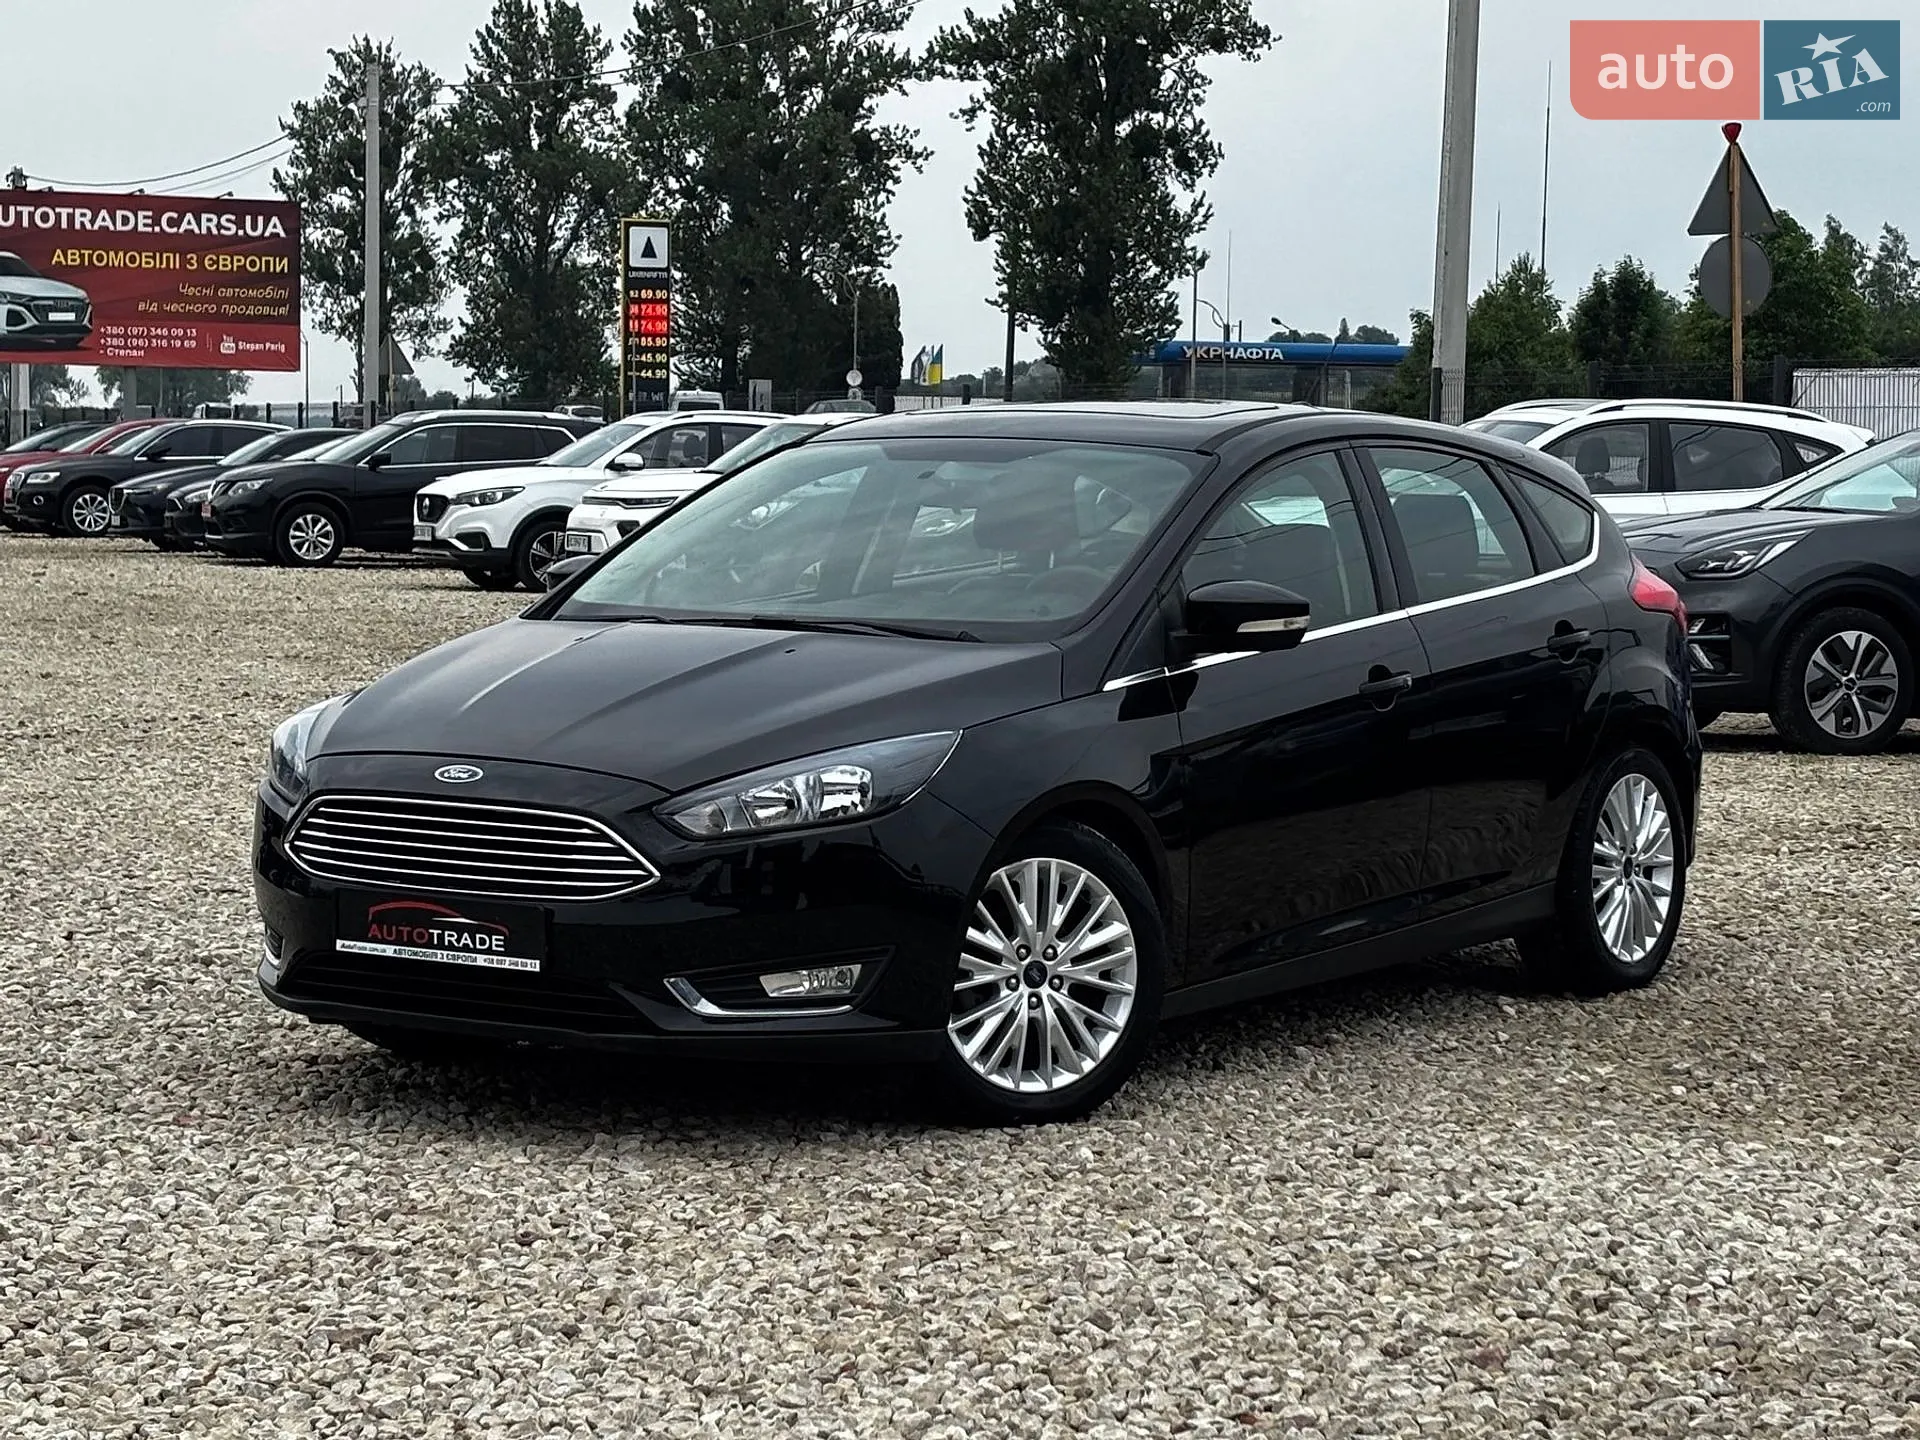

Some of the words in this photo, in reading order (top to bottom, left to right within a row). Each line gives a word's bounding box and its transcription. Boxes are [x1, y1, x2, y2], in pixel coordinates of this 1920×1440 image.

[51, 249, 180, 270] АВТОМОБІЛІ
[204, 254, 289, 274] ЄВРОПИ
[179, 283, 215, 296] Чесні
[217, 286, 289, 299] автомобілі
[138, 300, 158, 313] від
[163, 303, 217, 313] чесного
[100, 326, 125, 335] +380
[150, 327, 168, 336] 346
[186, 328, 197, 337] 13
[100, 337, 125, 346] +380
[106, 347, 145, 357] Степан
[1183, 346, 1284, 361] УКРНАФТА
[368, 923, 506, 951] AUTOTRADE
